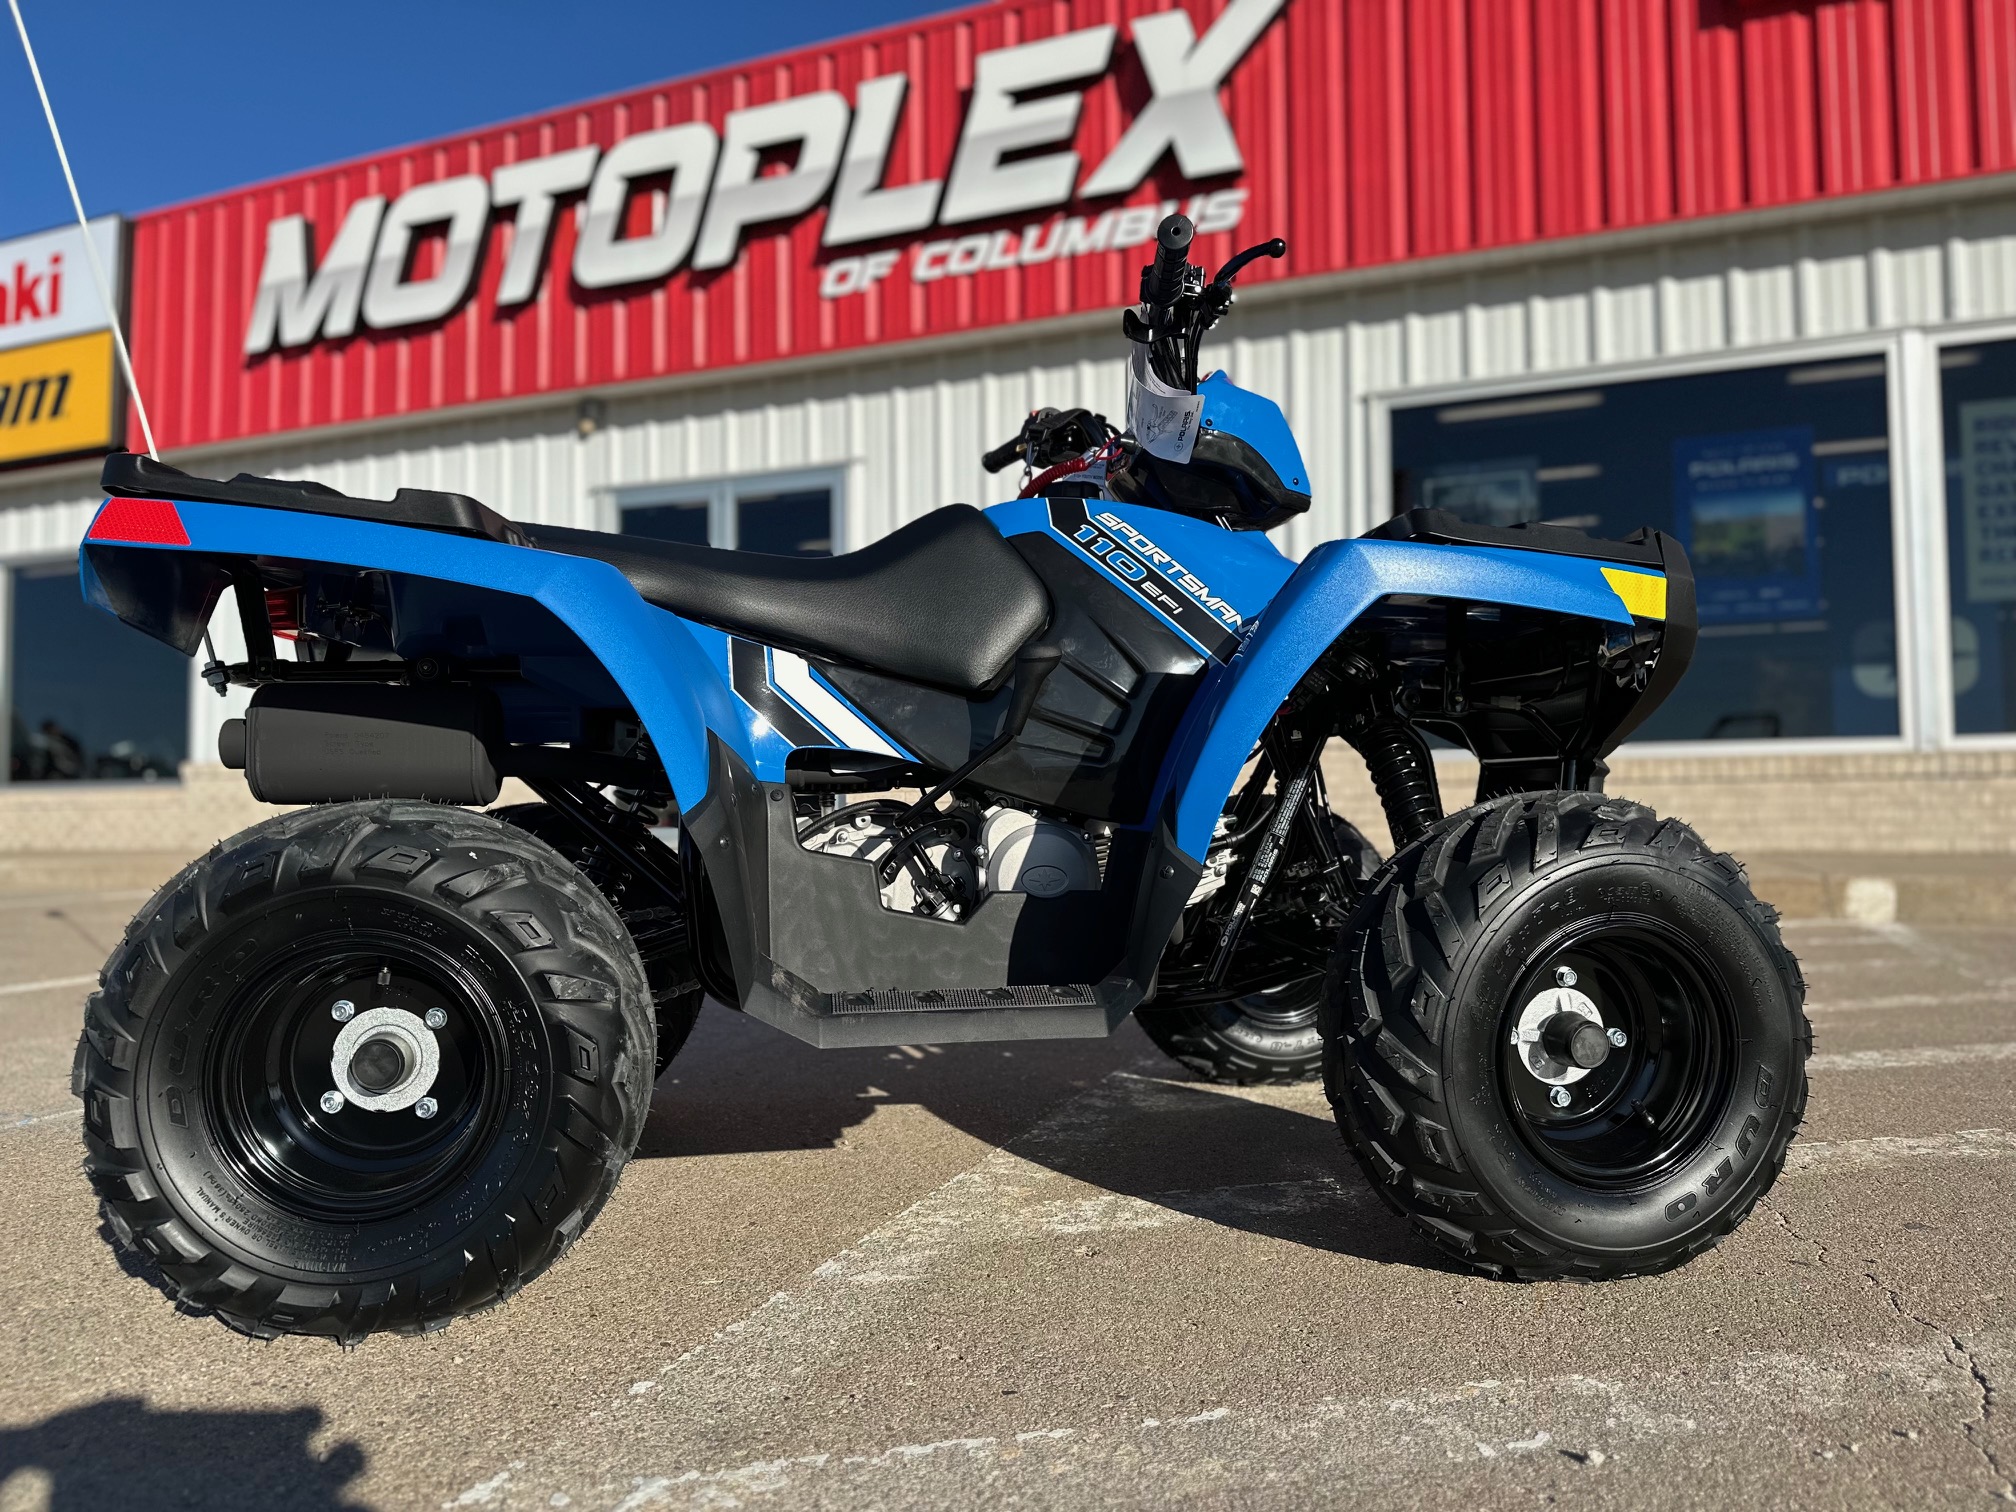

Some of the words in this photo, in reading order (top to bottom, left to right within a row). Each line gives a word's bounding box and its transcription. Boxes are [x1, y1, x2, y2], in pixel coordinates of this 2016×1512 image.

[244, 0, 1288, 355] MOTOPLEX
[819, 250, 899, 299] OF
[1073, 524, 1147, 581] 110
[1140, 581, 1183, 615] EFI
[1095, 512, 1251, 634] SPORTSMAN
[1665, 1064, 1776, 1223] DURO
[193, 1185, 222, 1214] MANUAL
